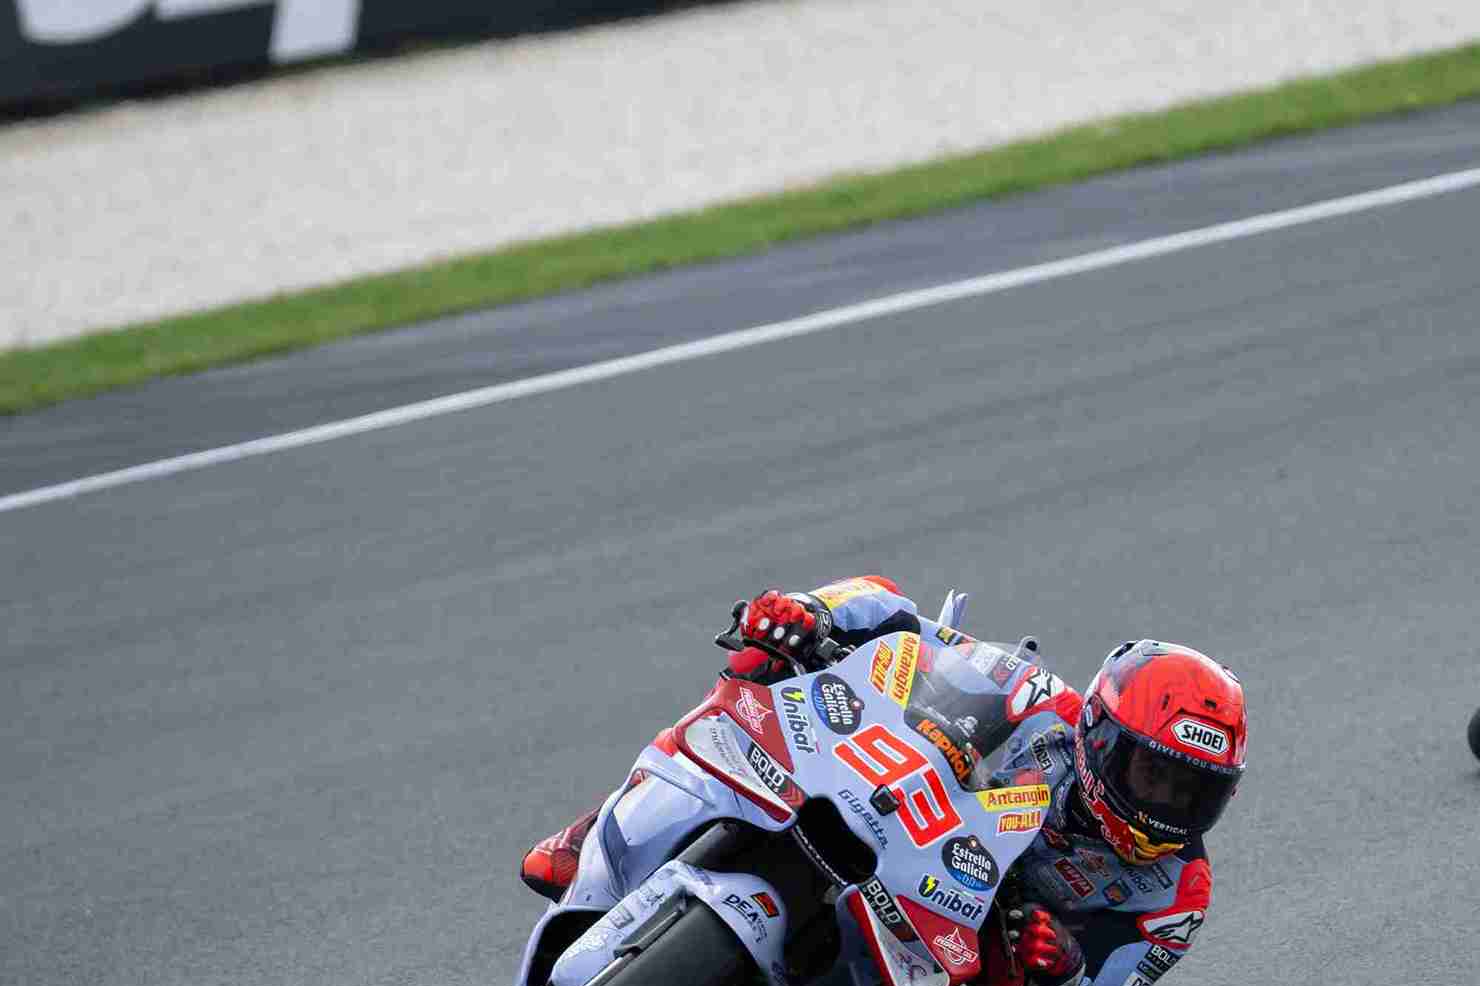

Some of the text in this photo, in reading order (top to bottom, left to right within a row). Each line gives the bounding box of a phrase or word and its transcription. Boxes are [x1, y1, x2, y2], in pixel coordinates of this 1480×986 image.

[893, 636, 916, 699] Antangin
[781, 687, 815, 753] Unibat
[821, 684, 840, 723] Galicia
[833, 682, 854, 725] Estrella
[1182, 723, 1224, 752] SHOEI
[751, 747, 784, 786] BOLD
[832, 722, 966, 849] 93
[987, 786, 1048, 807] Antangin
[1149, 817, 1188, 836] VERTICAL
[952, 843, 991, 870] Estrella
[952, 856, 988, 882] Galicia
[867, 880, 901, 923] BOLD
[919, 873, 984, 921] Unibat
